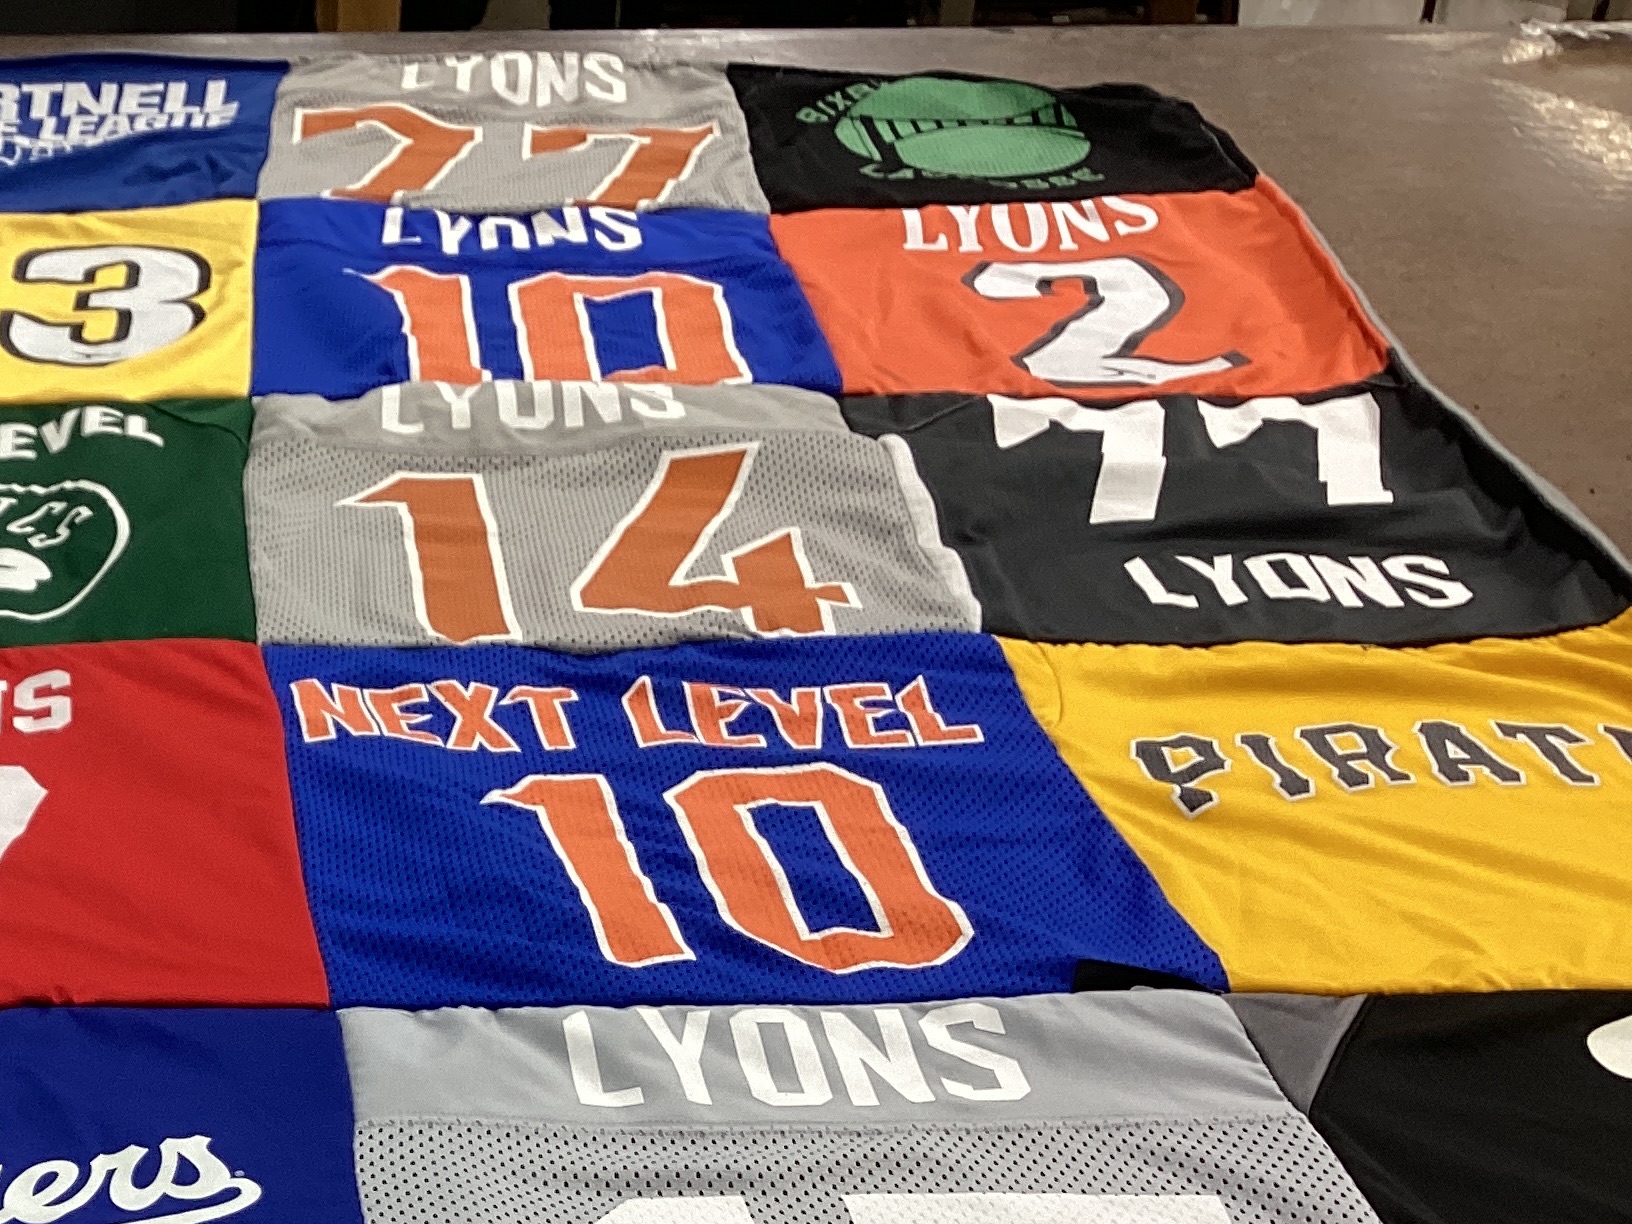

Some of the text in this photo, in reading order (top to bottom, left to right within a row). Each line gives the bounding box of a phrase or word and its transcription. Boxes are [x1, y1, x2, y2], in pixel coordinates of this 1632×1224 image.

[400, 51, 627, 108] LYONS
[292, 103, 720, 212] 77
[381, 205, 643, 256] LYONS
[900, 195, 1160, 253] LYONS
[343, 264, 754, 385] 10
[961, 255, 1252, 388] 2
[381, 379, 686, 434] LYONS
[986, 392, 1395, 524] 77
[335, 440, 863, 645] 14
[1124, 551, 1474, 609] LYONS
[290, 674, 985, 753] NEXT LEVEL
[1129, 719, 1632, 819] PIRAT
[480, 761, 975, 975] 10
[561, 1002, 1034, 1109] LYONS
